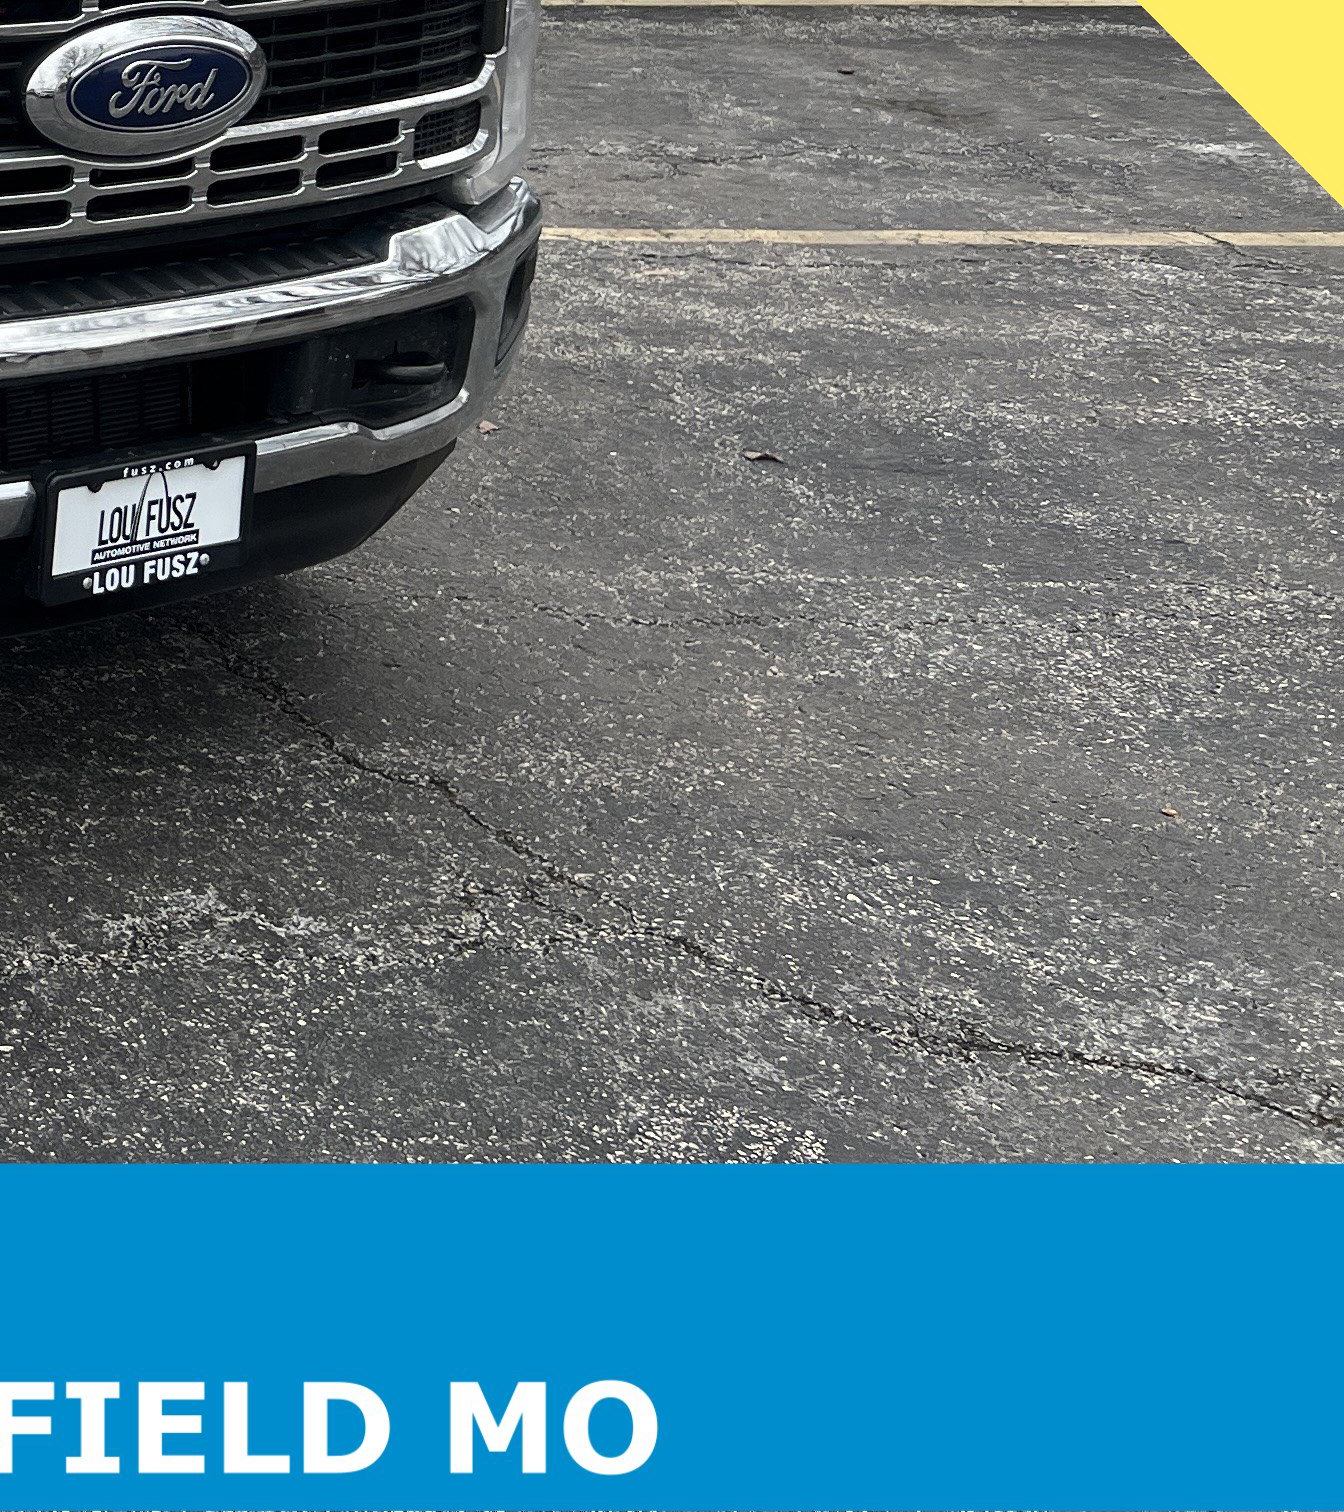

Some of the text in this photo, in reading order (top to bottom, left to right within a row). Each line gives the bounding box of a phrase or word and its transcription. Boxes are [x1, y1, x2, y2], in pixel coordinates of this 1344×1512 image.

[108, 57, 219, 119] Ford
[123, 456, 195, 478] fusz.com
[97, 492, 197, 547] LOU FUSZ
[93, 533, 198, 562] AUTOMOTIVE NETWORK
[92, 551, 200, 595] LOU FUSZ
